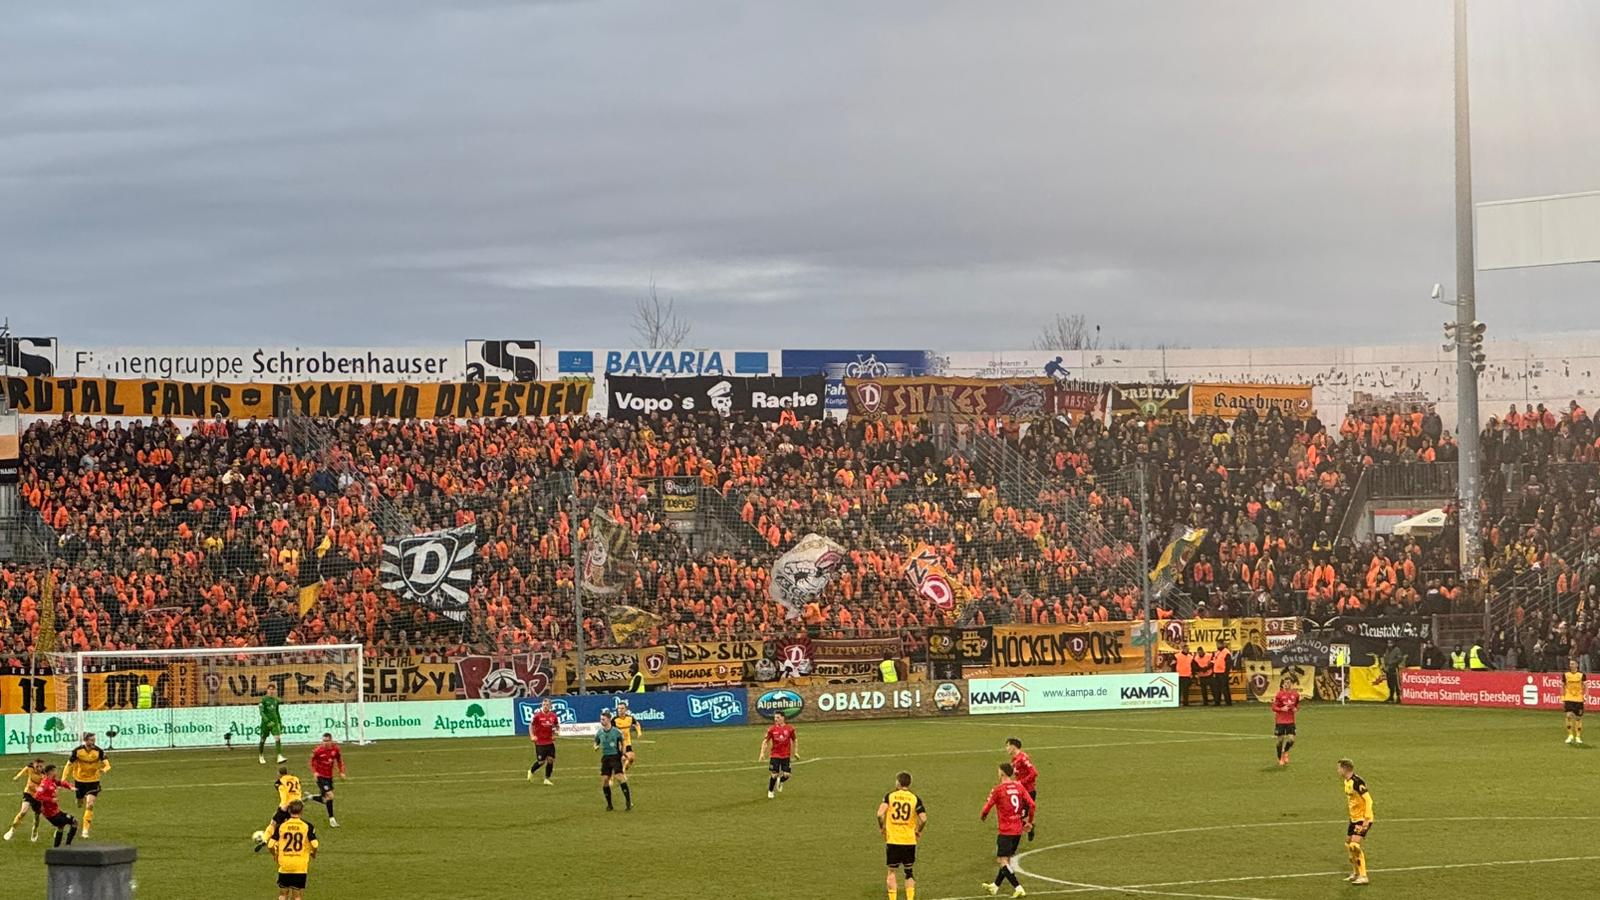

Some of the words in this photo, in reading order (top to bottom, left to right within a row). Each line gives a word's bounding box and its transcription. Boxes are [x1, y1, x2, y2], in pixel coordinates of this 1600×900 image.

[252, 350, 448, 374] Schrobenhauser
[606, 350, 724, 374] BAVARIA
[142, 381, 231, 418] FANS
[434, 382, 588, 418] DRESDEN
[752, 391, 819, 409] Rache
[893, 384, 988, 415] SNAKES
[1120, 388, 1180, 401] FREITAL
[963, 640, 982, 657] 53
[228, 669, 356, 697] ULTRAS
[589, 669, 629, 683] WEST
[668, 668, 713, 679] BRIGADE
[1402, 672, 1461, 685] Kreissparkasse
[818, 691, 886, 711] OBAZD
[893, 689, 921, 708] IS!
[970, 690, 1021, 705] KAMPA
[1042, 686, 1108, 698] www.kampa.de
[1120, 685, 1169, 700] KAMPA
[1402, 688, 1439, 700] München
[1440, 690, 1479, 703] Starnberg
[1479, 691, 1521, 705] Ebersberg
[691, 692, 732, 713] Bayern
[713, 702, 741, 721] Park
[757, 700, 802, 709] Alpenhain
[109, 724, 135, 736] Das
[138, 722, 213, 735] Bio-Bonbon
[433, 716, 512, 731] Alpenbauer
[891, 801, 912, 821] 39
[1010, 794, 1020, 814] 9
[283, 832, 304, 853] 28
